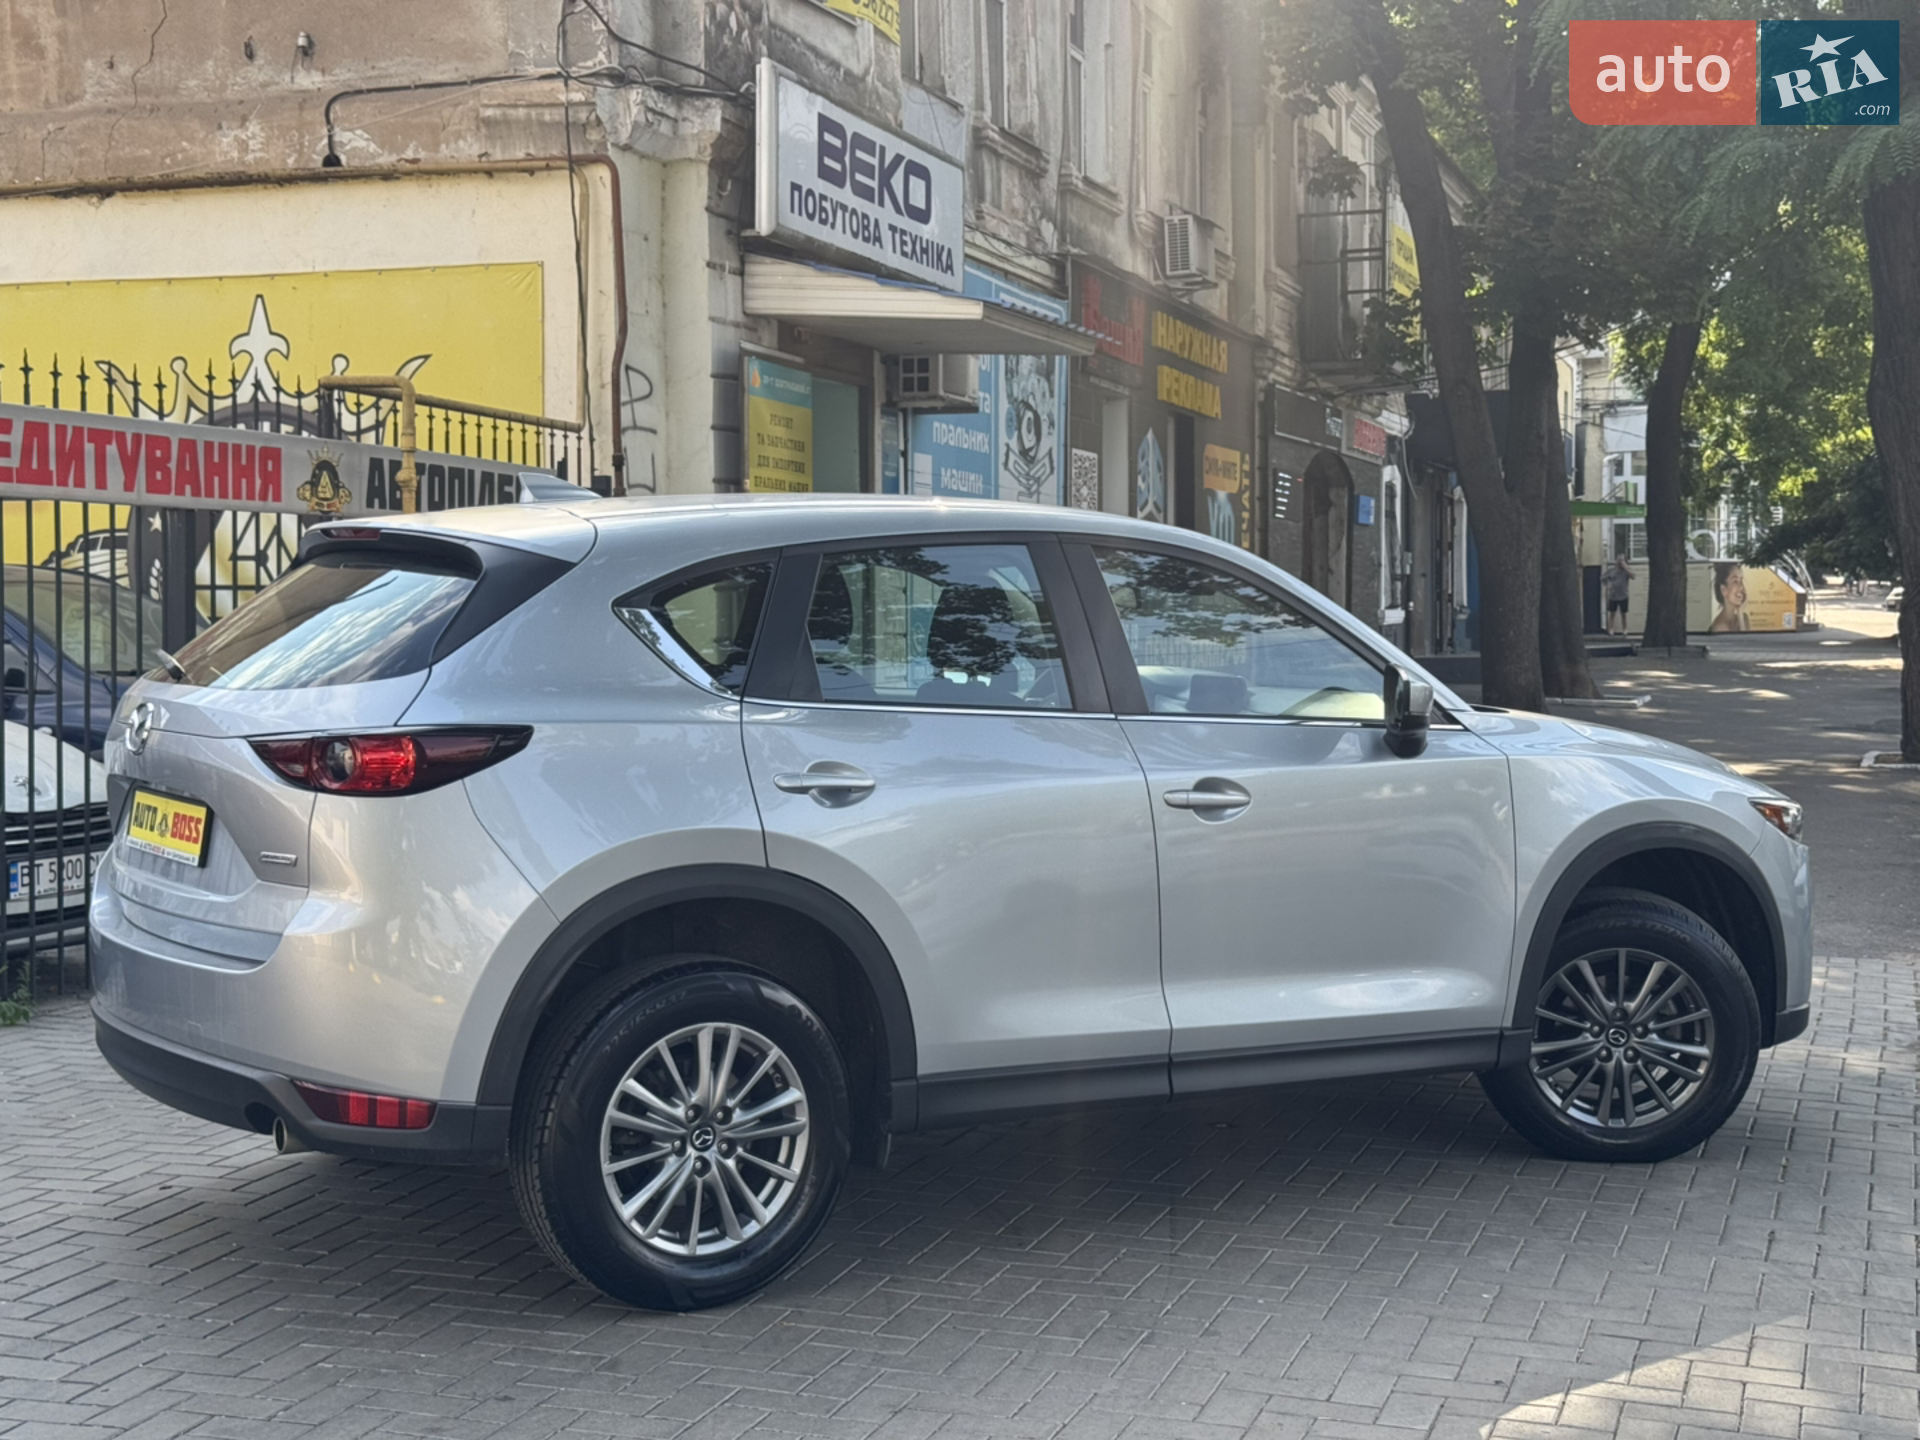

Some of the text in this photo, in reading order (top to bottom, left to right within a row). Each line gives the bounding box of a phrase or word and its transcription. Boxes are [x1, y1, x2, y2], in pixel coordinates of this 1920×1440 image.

[817, 111, 932, 226] BEKO
[790, 180, 955, 277] ПОБУТОВА ТЕХНІКА
[1153, 311, 1228, 375] НАРУЖНАЯ
[1157, 365, 1222, 420] РЕКЛАМА
[932, 420, 990, 455] пральних
[366, 457, 521, 511] АВТОПІДБ
[940, 466, 984, 495] машин
[132, 801, 203, 845] AUTO BOSS
[48, 858, 83, 883] 500
